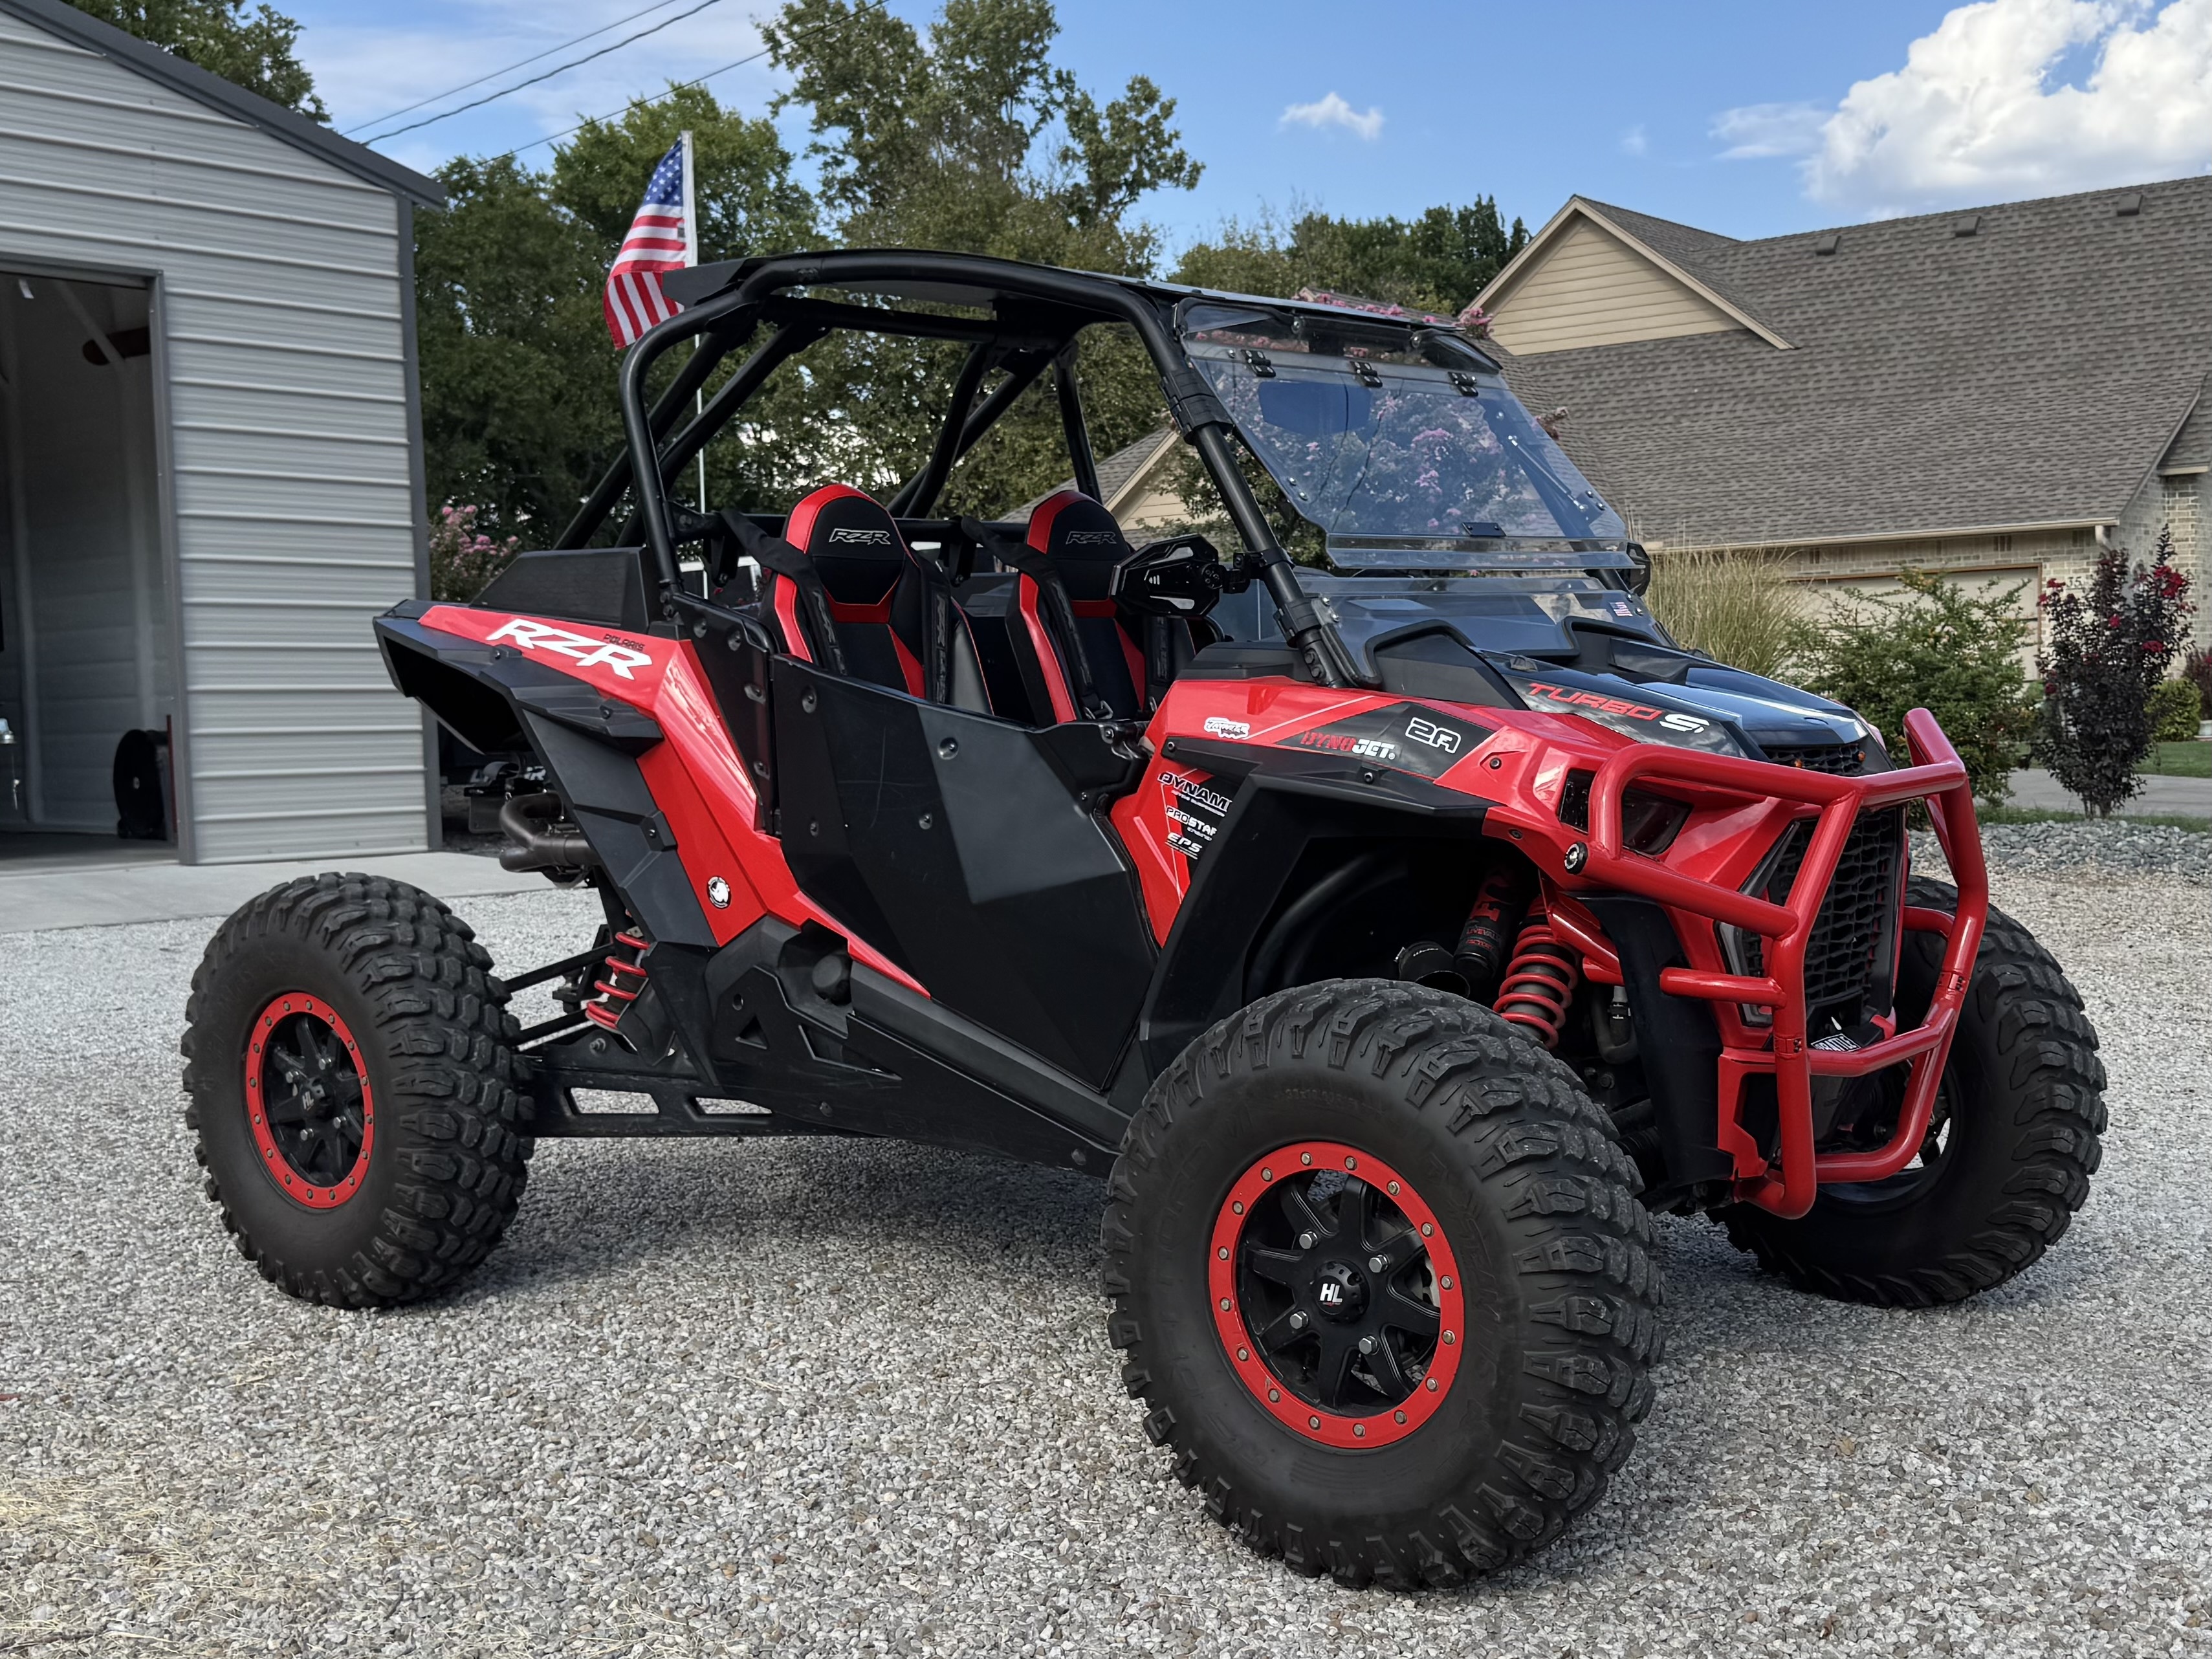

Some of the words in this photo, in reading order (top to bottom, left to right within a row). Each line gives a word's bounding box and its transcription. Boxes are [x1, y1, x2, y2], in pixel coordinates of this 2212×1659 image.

[829, 528, 892, 545] RZR
[1066, 531, 1117, 545] RZR
[486, 619, 653, 680] RZR
[603, 633, 645, 651] POLARIS
[1528, 683, 1663, 721] TURBO
[1659, 714, 1710, 734] S
[1157, 771, 1232, 813] DYNAM
[1167, 832, 1203, 853] EPS
[1320, 1283, 1343, 1302] HL
